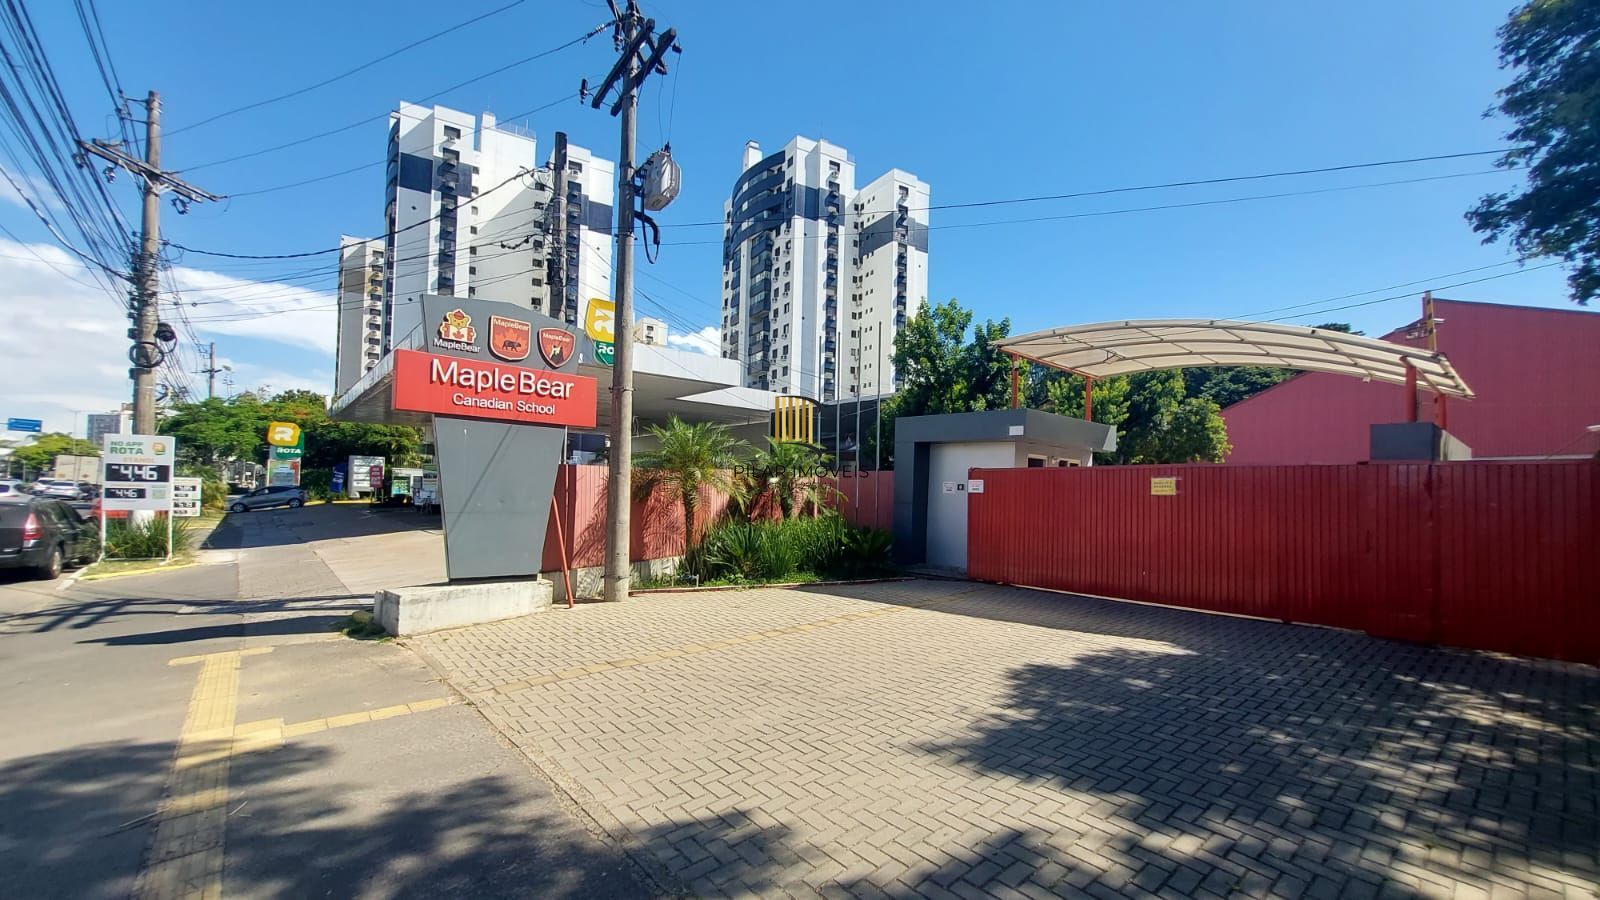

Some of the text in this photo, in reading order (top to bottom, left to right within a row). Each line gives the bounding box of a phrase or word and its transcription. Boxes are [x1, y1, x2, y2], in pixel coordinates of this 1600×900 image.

[493, 318, 530, 331] MapleBear
[433, 337, 481, 353] MapleBear
[597, 342, 615, 355] RO
[430, 358, 575, 398] Maple Bear
[452, 393, 556, 415] Canadian School
[110, 447, 144, 455] ROTA
